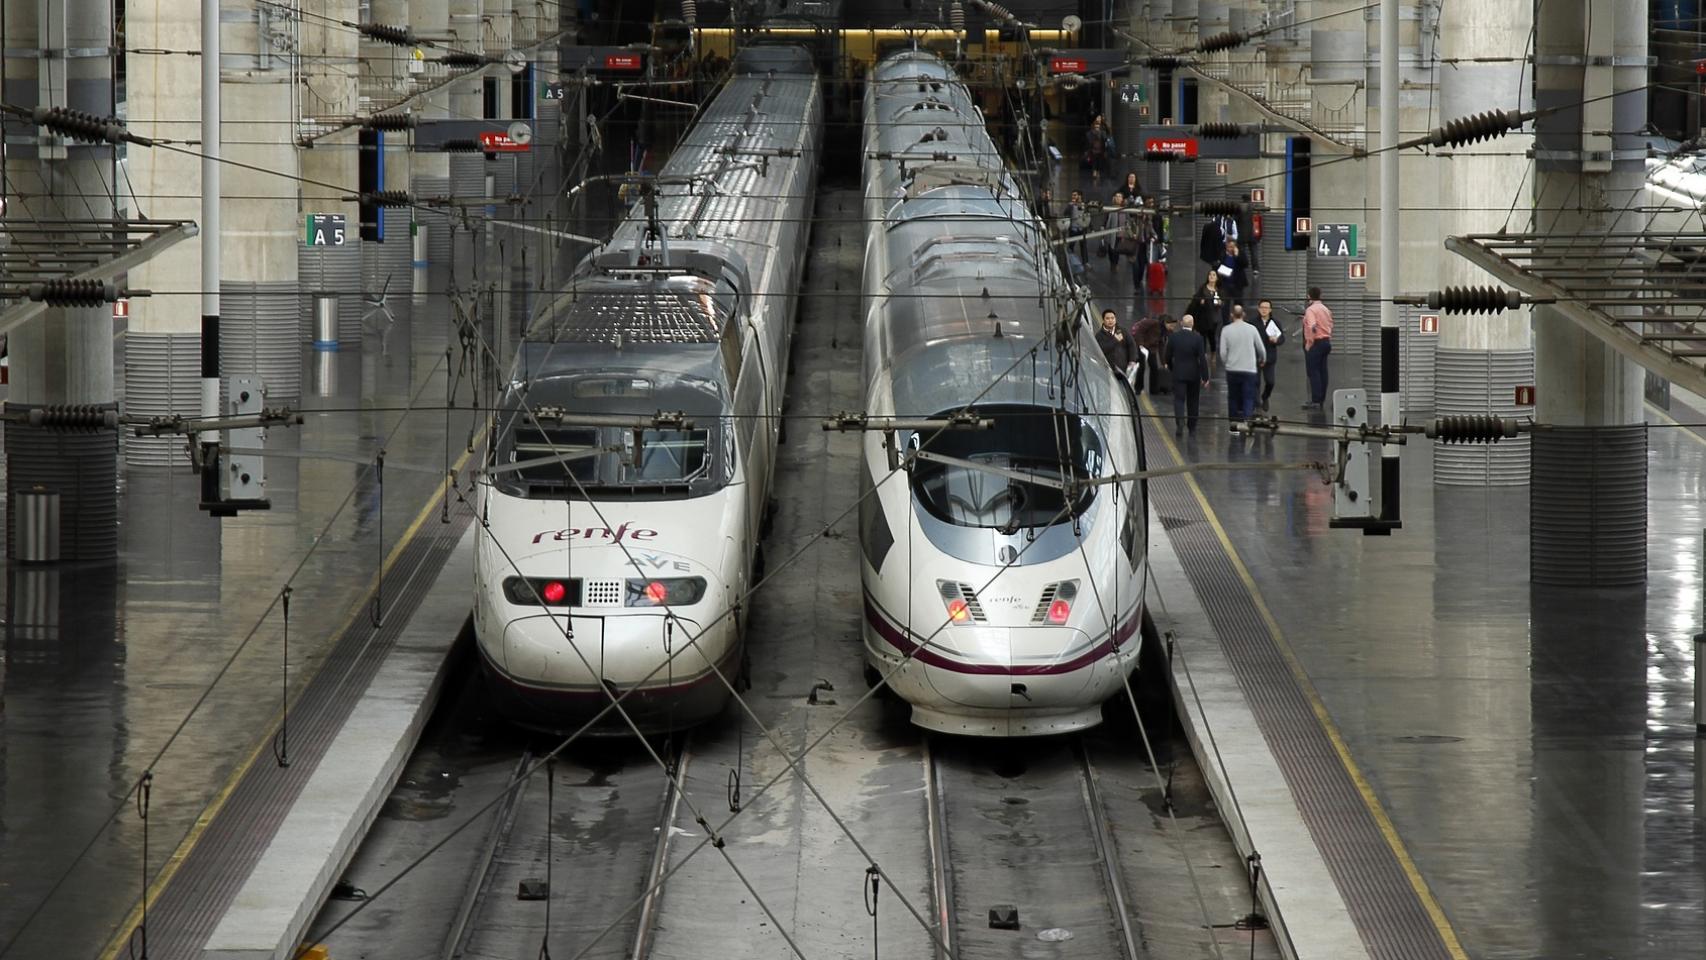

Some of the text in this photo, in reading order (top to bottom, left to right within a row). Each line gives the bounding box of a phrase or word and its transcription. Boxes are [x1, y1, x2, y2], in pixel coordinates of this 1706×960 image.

[546, 88, 564, 99] A 5
[1121, 92, 1140, 102] 4 A
[314, 228, 345, 246] A 5
[1318, 238, 1350, 256] 4 A
[532, 521, 658, 545] renfe
[625, 552, 691, 573] AVE
